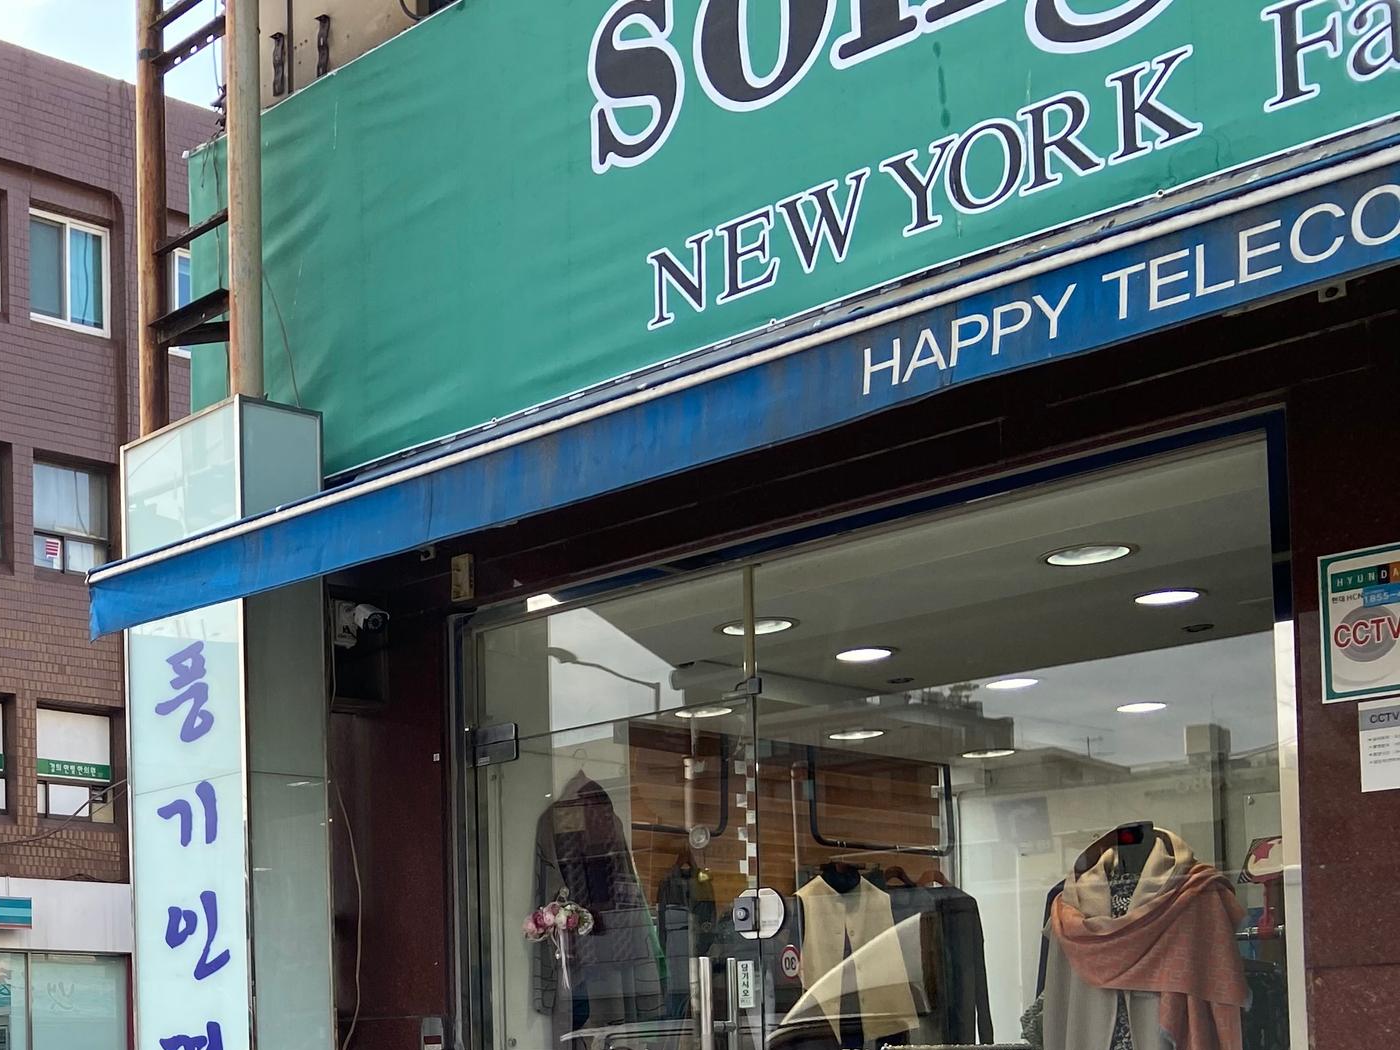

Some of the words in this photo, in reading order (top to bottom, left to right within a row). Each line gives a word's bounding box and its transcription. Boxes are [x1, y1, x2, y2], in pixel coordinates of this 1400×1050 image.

[647, 166, 871, 331] NEW
[879, 44, 1204, 238] YORK
[862, 283, 1077, 396] HAPPY
[1333, 614, 1400, 649] CCTV
[1369, 711, 1400, 724] CCTV
[740, 963, 750, 997] 당기시오
